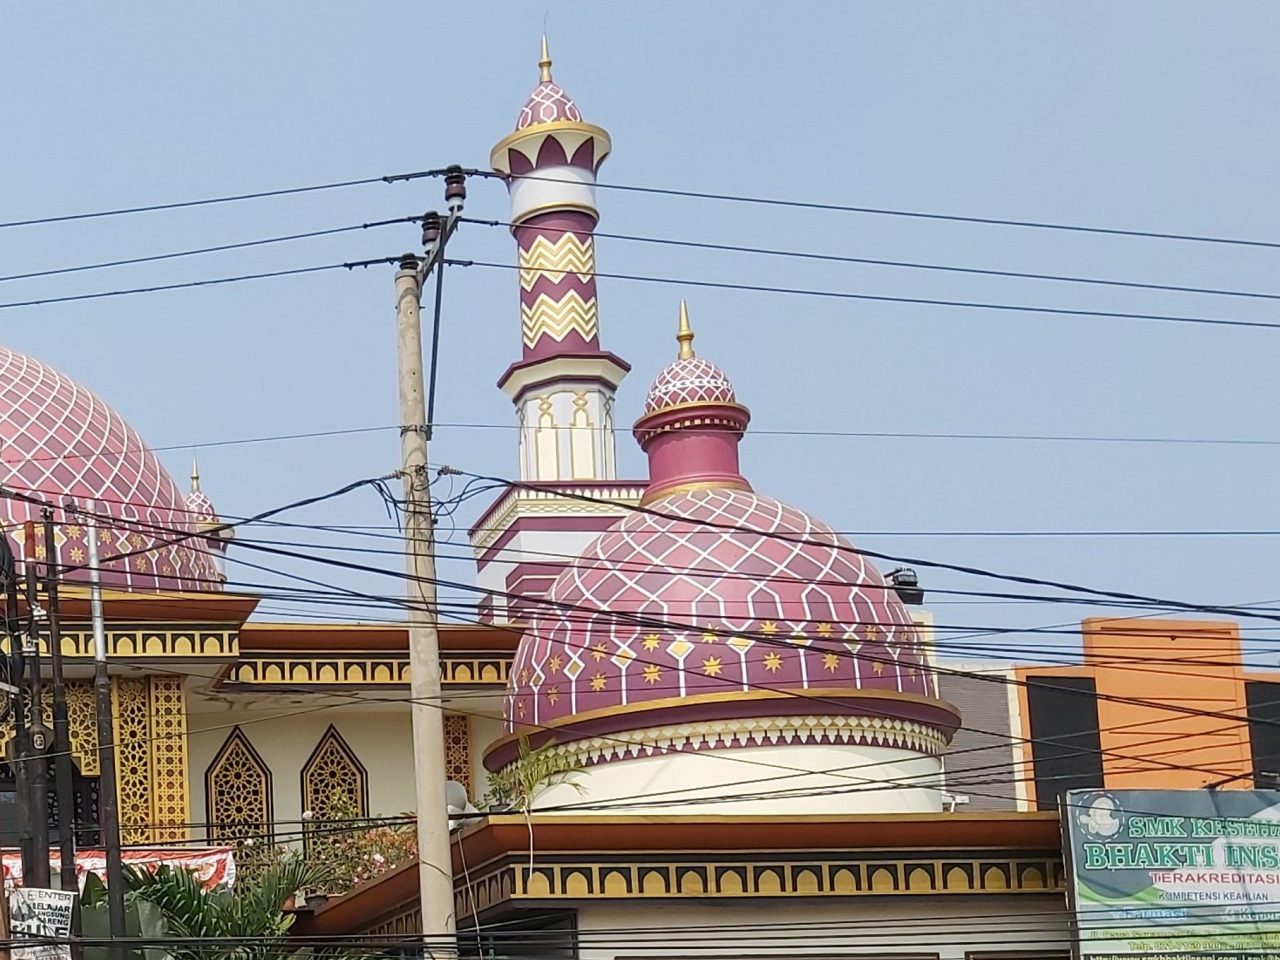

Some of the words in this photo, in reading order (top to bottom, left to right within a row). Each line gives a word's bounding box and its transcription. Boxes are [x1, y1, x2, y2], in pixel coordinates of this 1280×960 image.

[1128, 816, 1187, 837] SMK
[1084, 842, 1216, 869] BHAKTI
[1151, 872, 1280, 884] TERAKREDITASI
[1158, 892, 1221, 901] KOMPETENSI
[1223, 891, 1269, 901] KEAHLIAN
